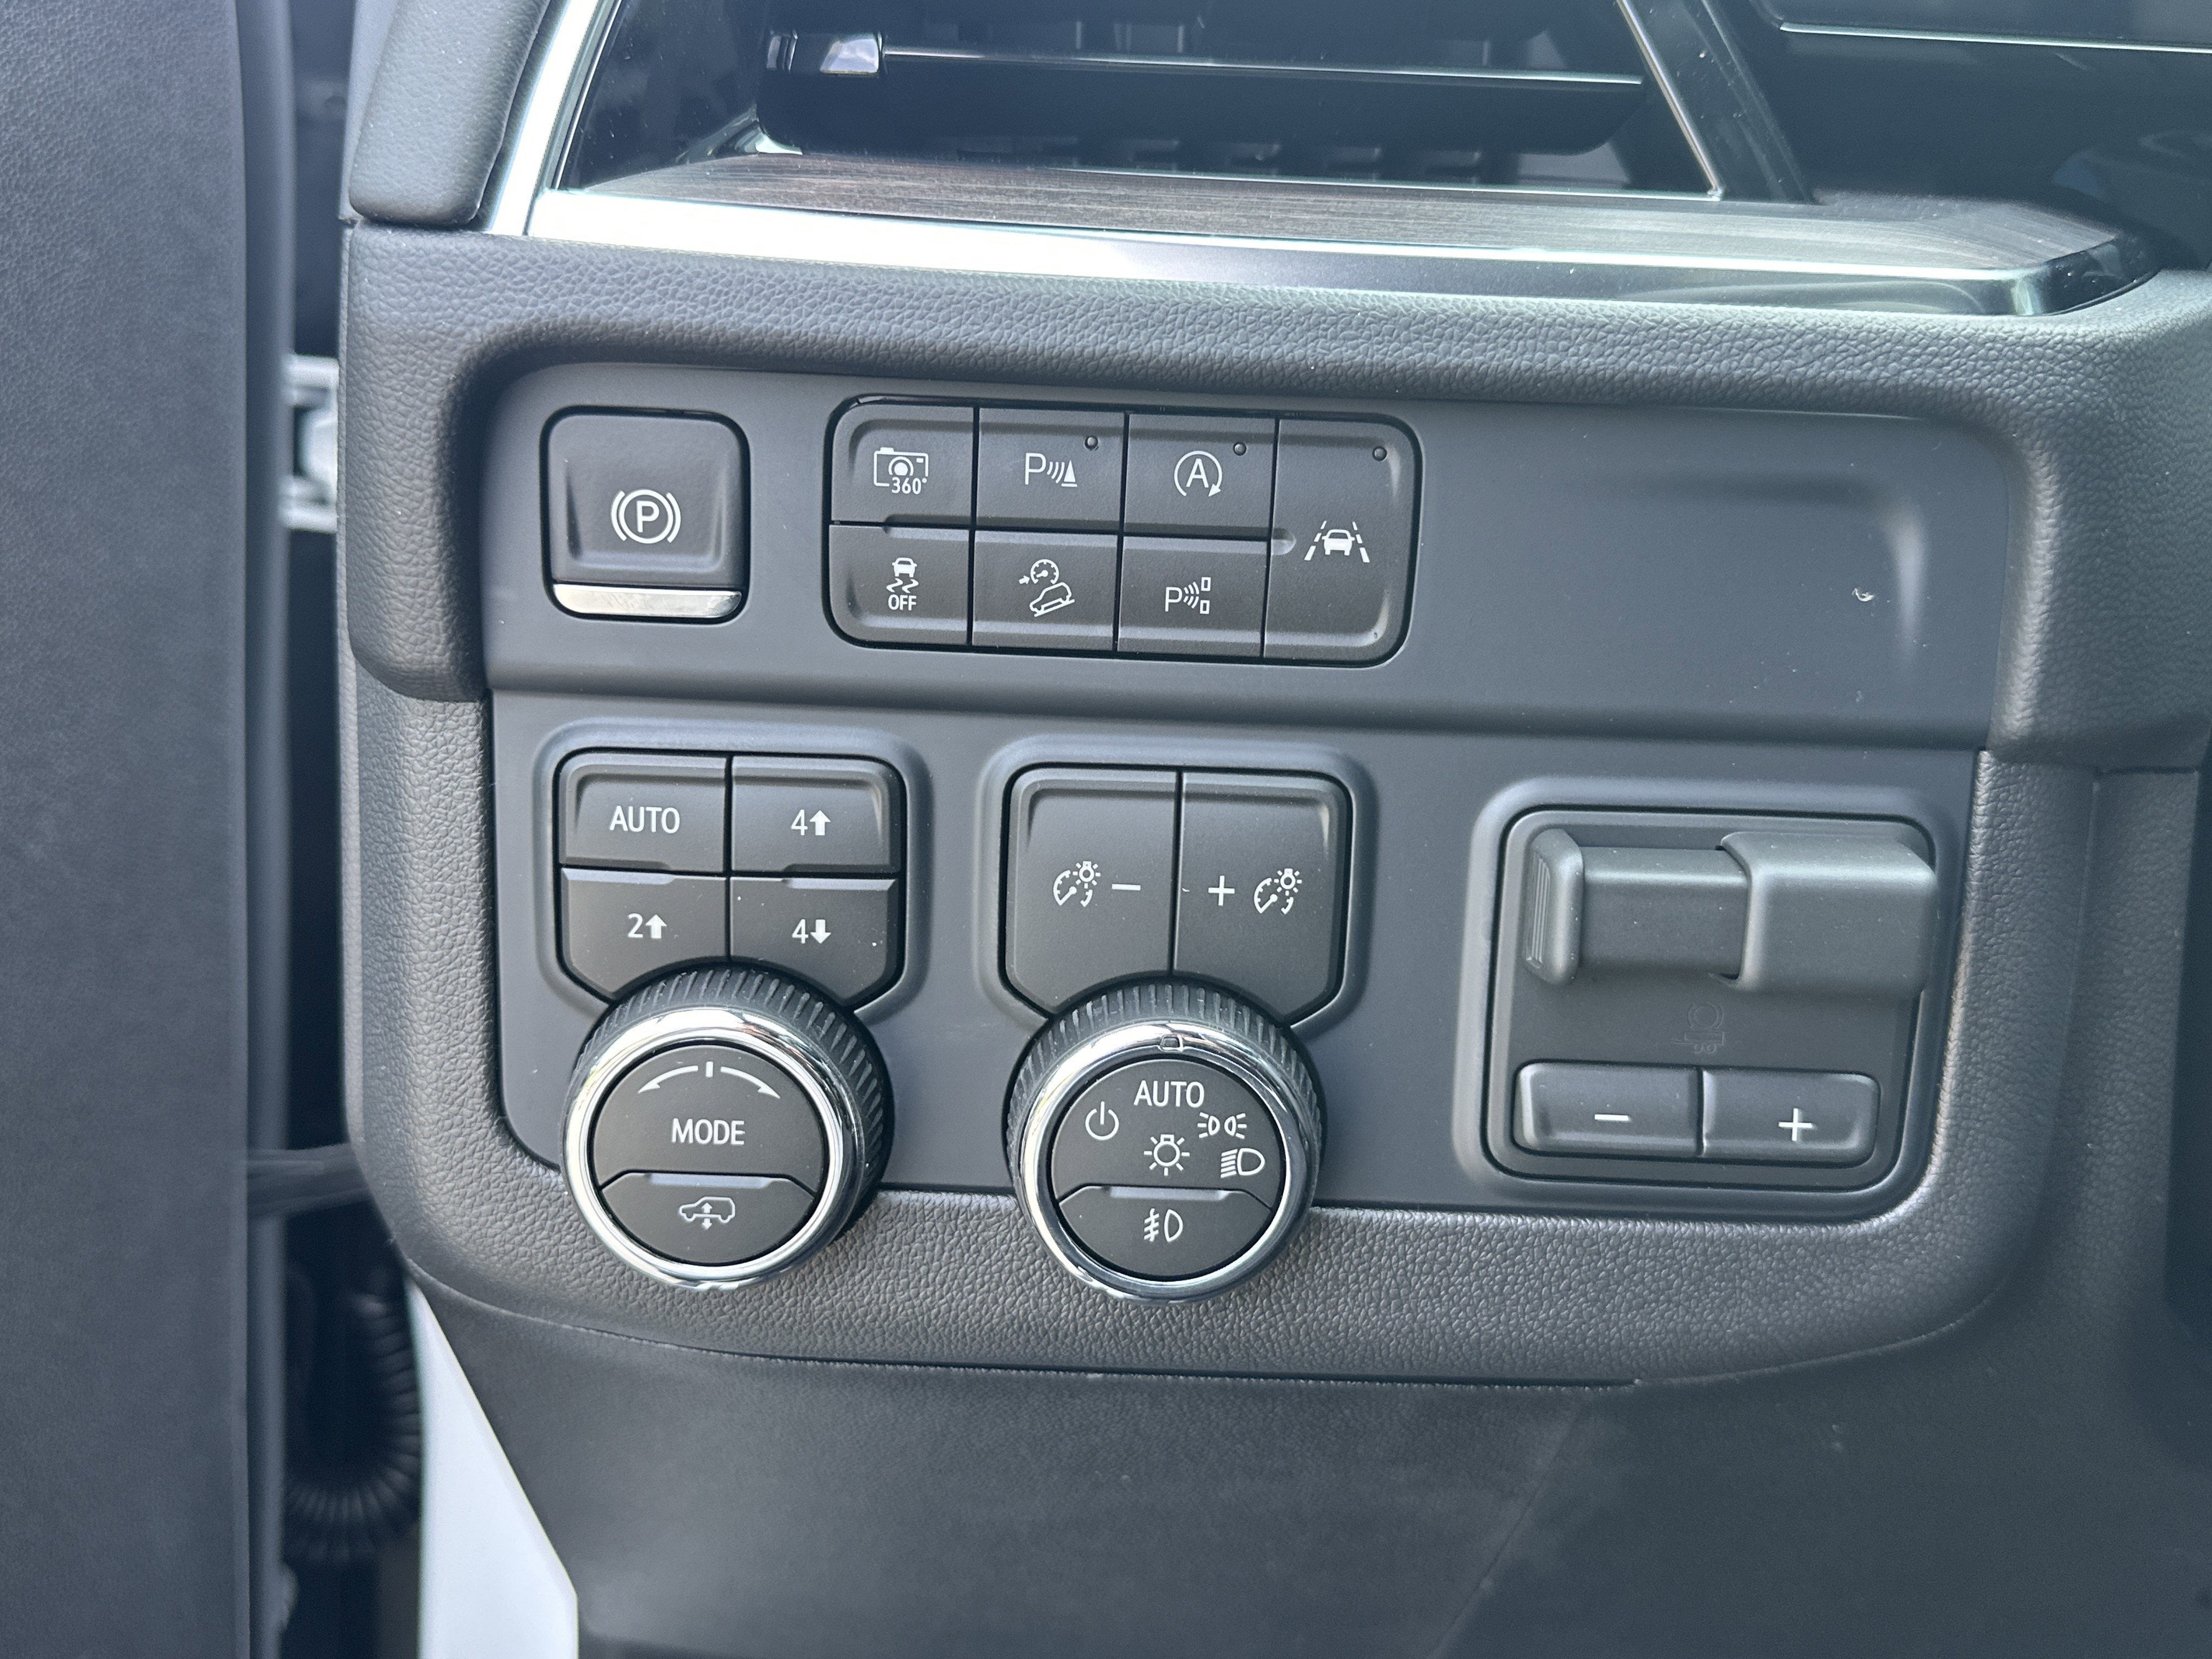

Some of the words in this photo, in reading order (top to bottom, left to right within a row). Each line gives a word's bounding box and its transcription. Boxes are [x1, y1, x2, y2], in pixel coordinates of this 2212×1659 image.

[1025, 452, 1045, 486] P
[1186, 459, 1210, 488] A
[635, 500, 660, 533] P
[887, 594, 917, 612] OFF
[1165, 586, 1182, 612] P
[609, 805, 681, 834] AUTO
[791, 809, 808, 836] 4
[627, 913, 644, 939] 2
[792, 919, 809, 944] 4
[1133, 1080, 1205, 1108] AUTO
[671, 1118, 746, 1146] MODE
